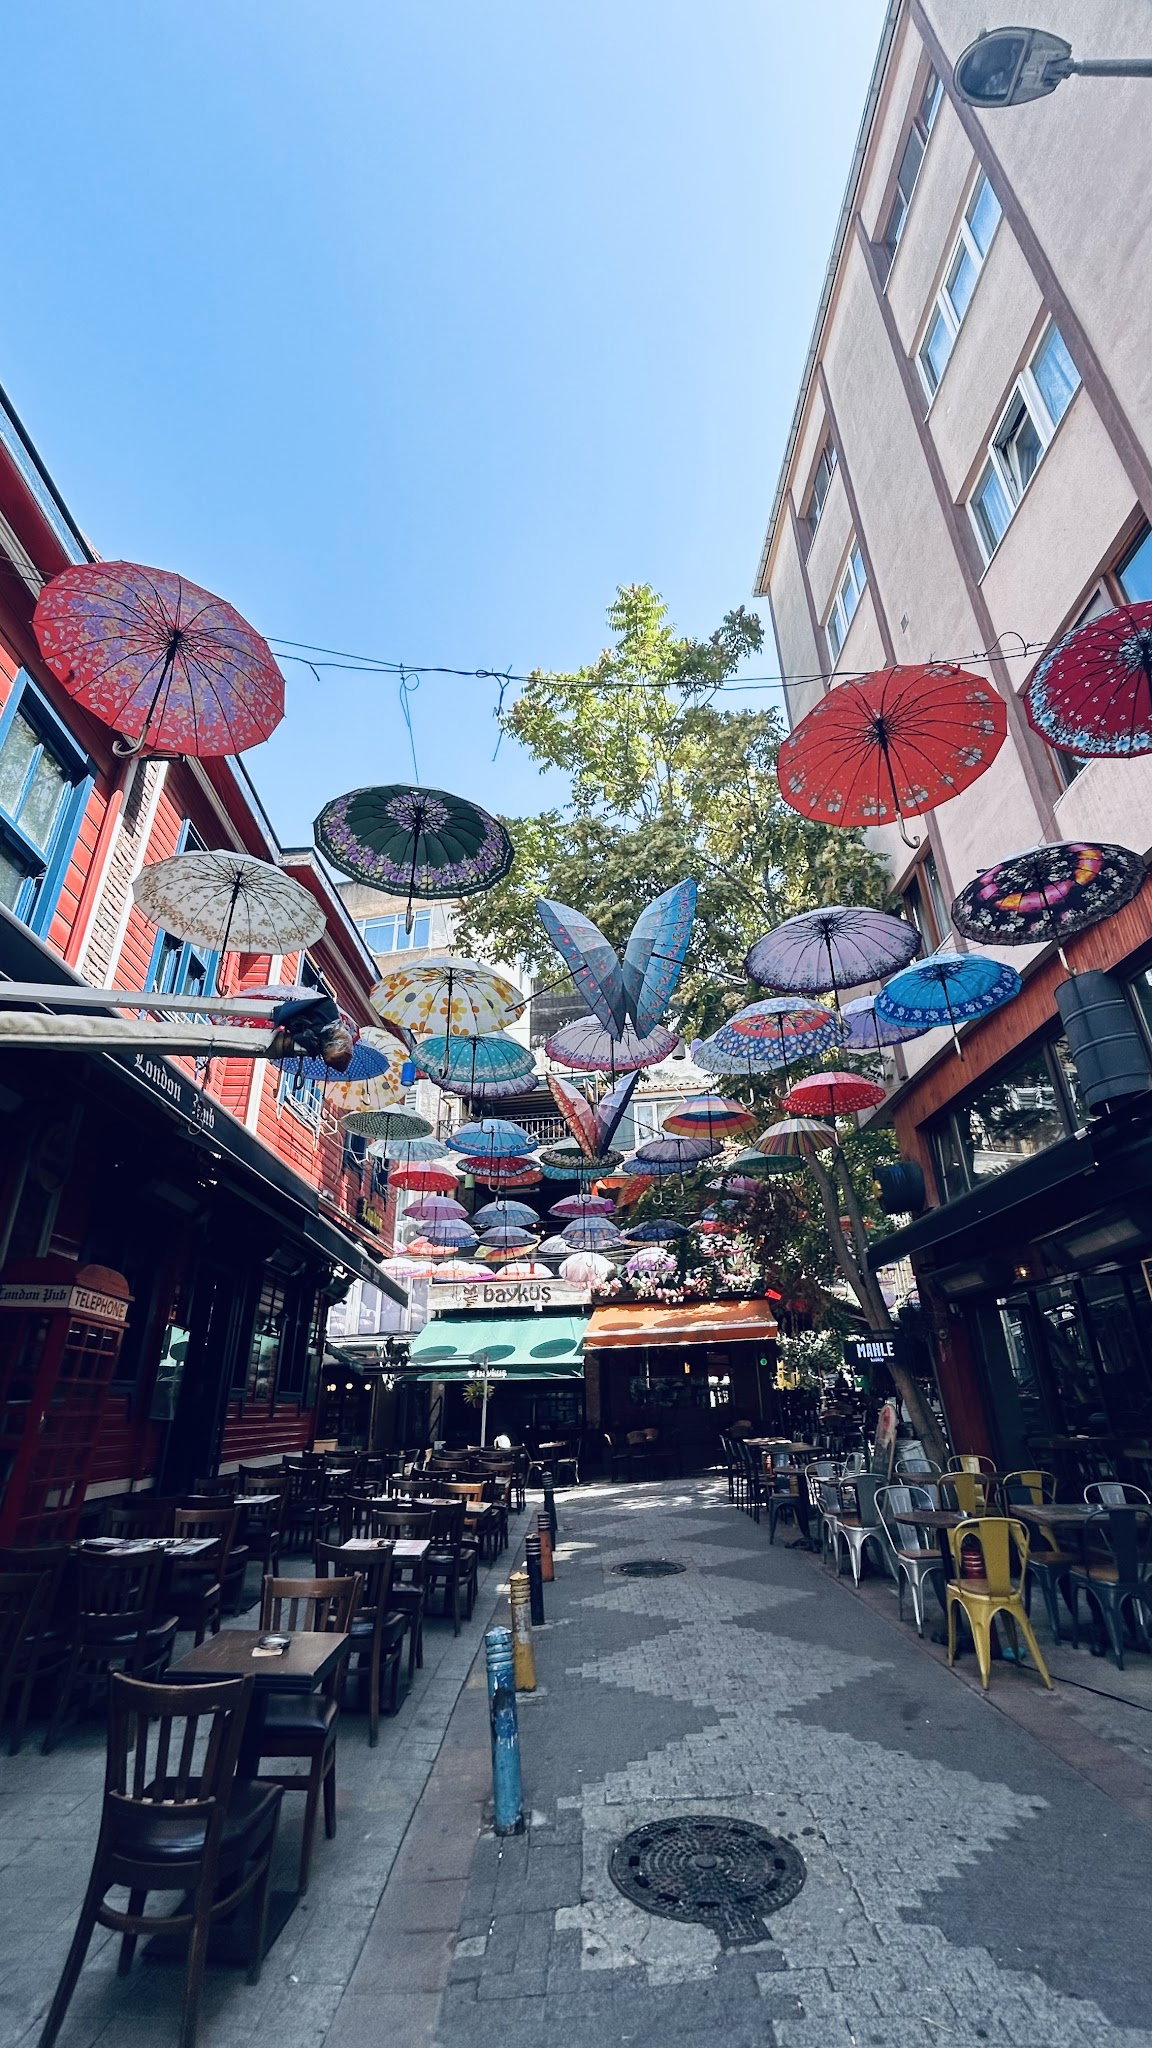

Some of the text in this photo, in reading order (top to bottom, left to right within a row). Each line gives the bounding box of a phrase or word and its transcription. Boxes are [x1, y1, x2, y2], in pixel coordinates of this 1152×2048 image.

[134, 1053, 182, 1102] London
[43, 1288, 67, 1303] Pub
[483, 1284, 552, 1303] baykuş
[74, 1290, 125, 1318] TELEPHONE
[856, 1341, 896, 1358] MAHLE
